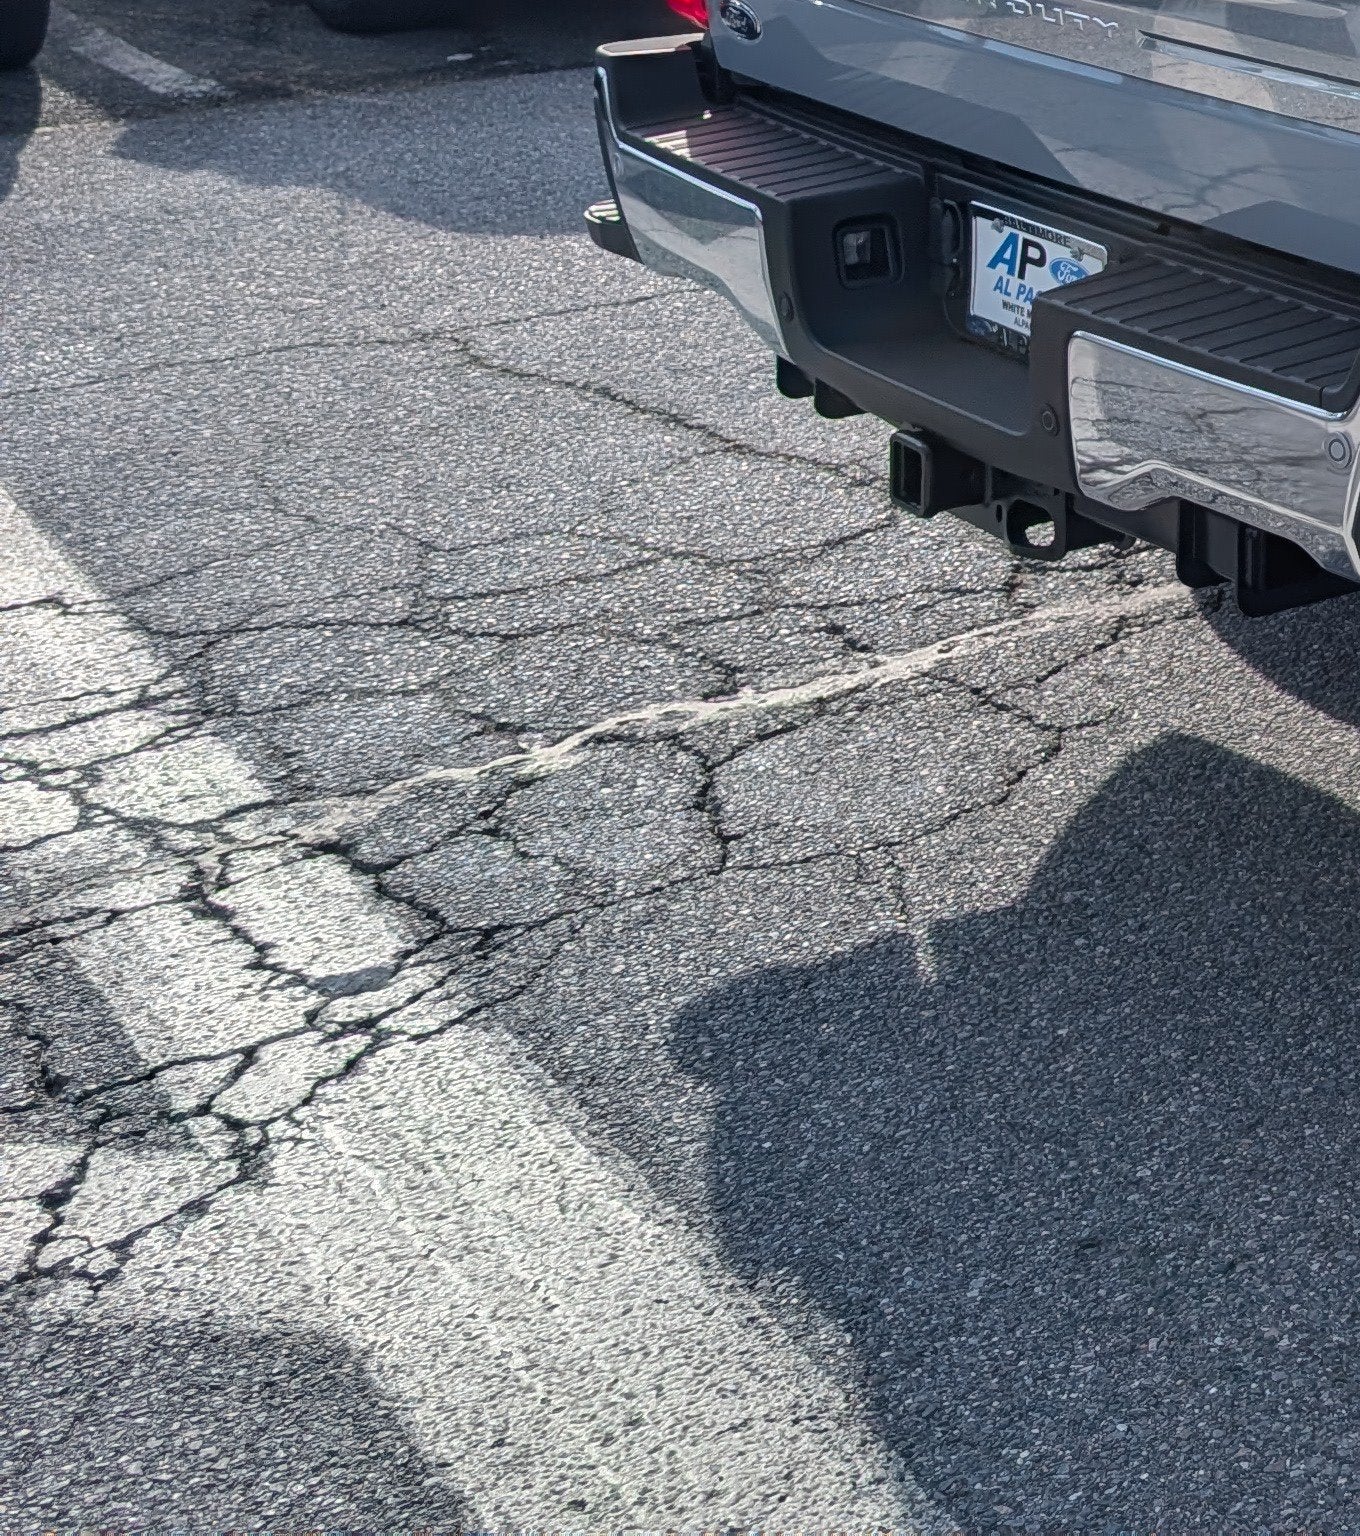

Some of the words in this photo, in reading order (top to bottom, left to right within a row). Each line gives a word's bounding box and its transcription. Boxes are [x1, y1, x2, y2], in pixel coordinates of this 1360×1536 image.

[1003, 216, 1070, 246] BALTIMORE
[986, 231, 1047, 280] AP
[993, 275, 1012, 297] AL
[1002, 299, 1025, 317] WHITE
